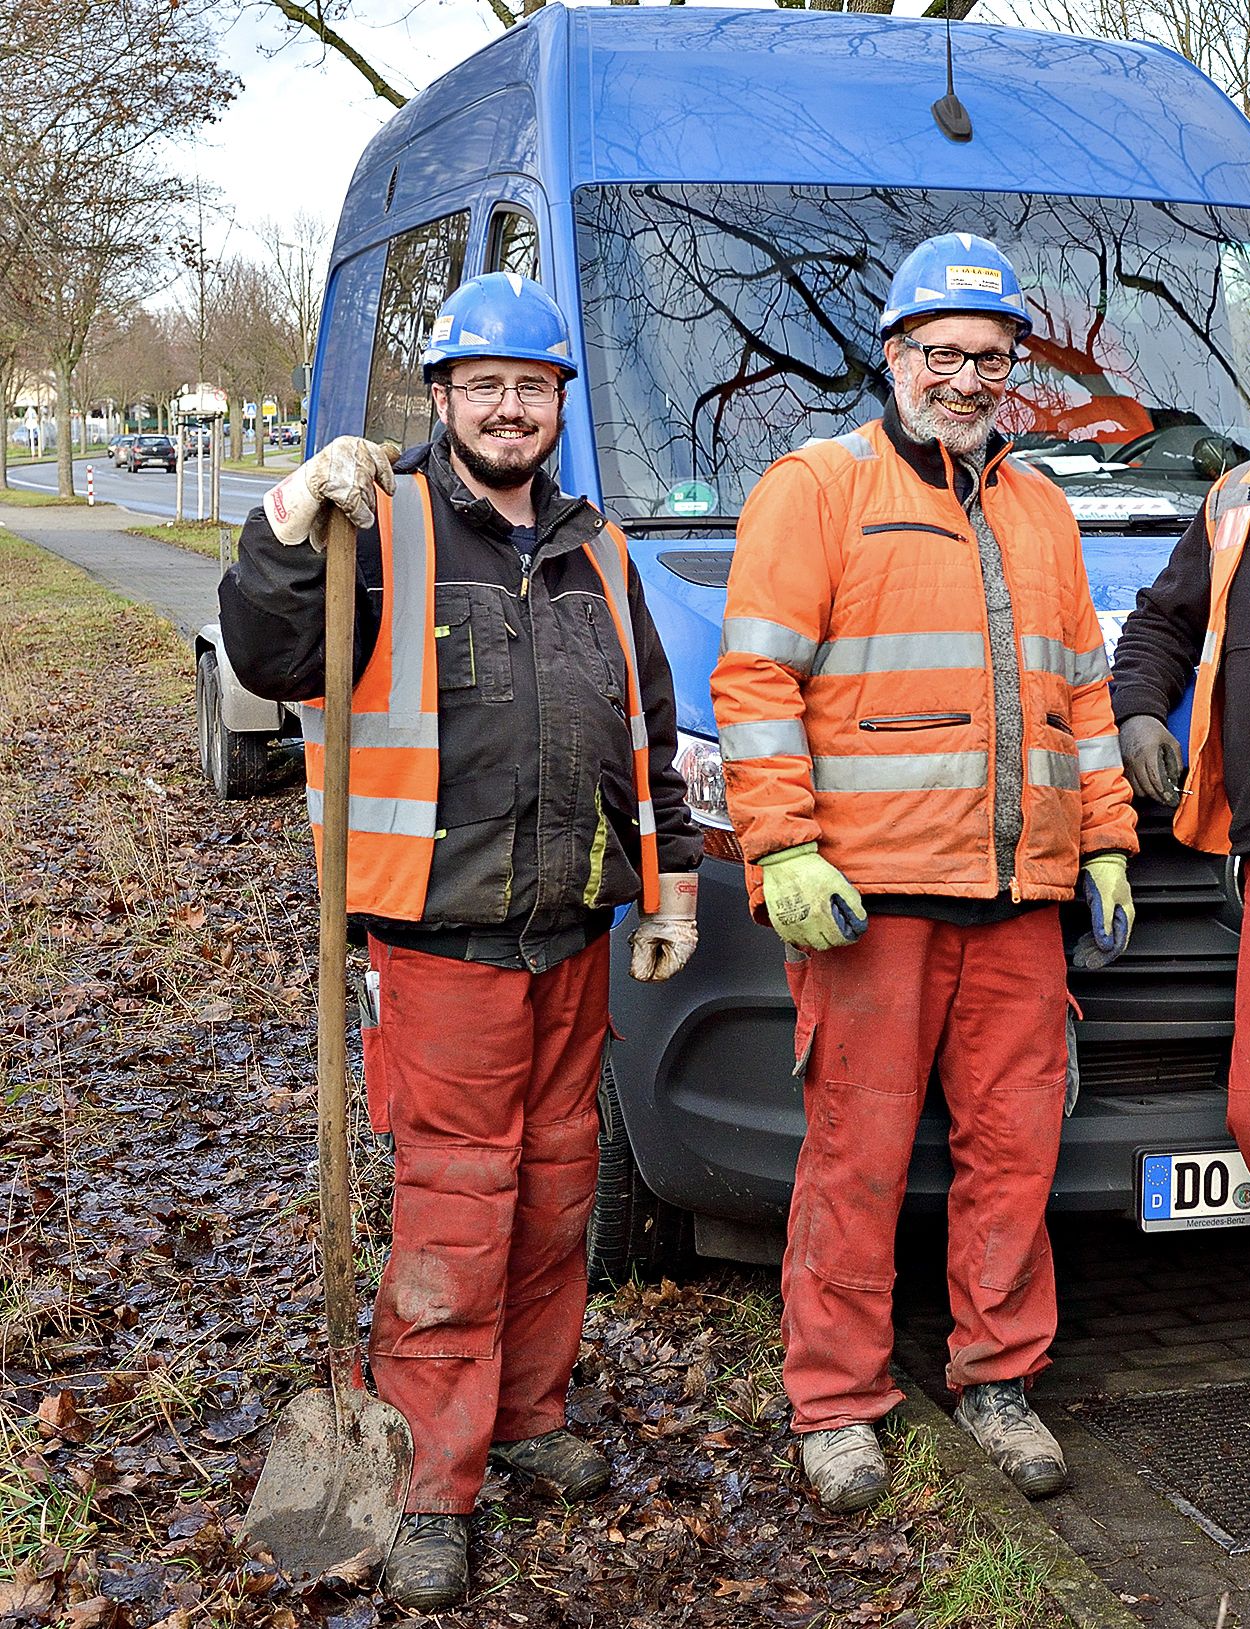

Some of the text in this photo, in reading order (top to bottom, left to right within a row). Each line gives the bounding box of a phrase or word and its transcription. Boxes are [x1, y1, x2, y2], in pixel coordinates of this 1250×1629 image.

[685, 484, 697, 501] 4
[1174, 1160, 1229, 1210] DO
[1151, 1194, 1163, 1208] D
[1186, 1216, 1245, 1228] Mercedes-Benz
